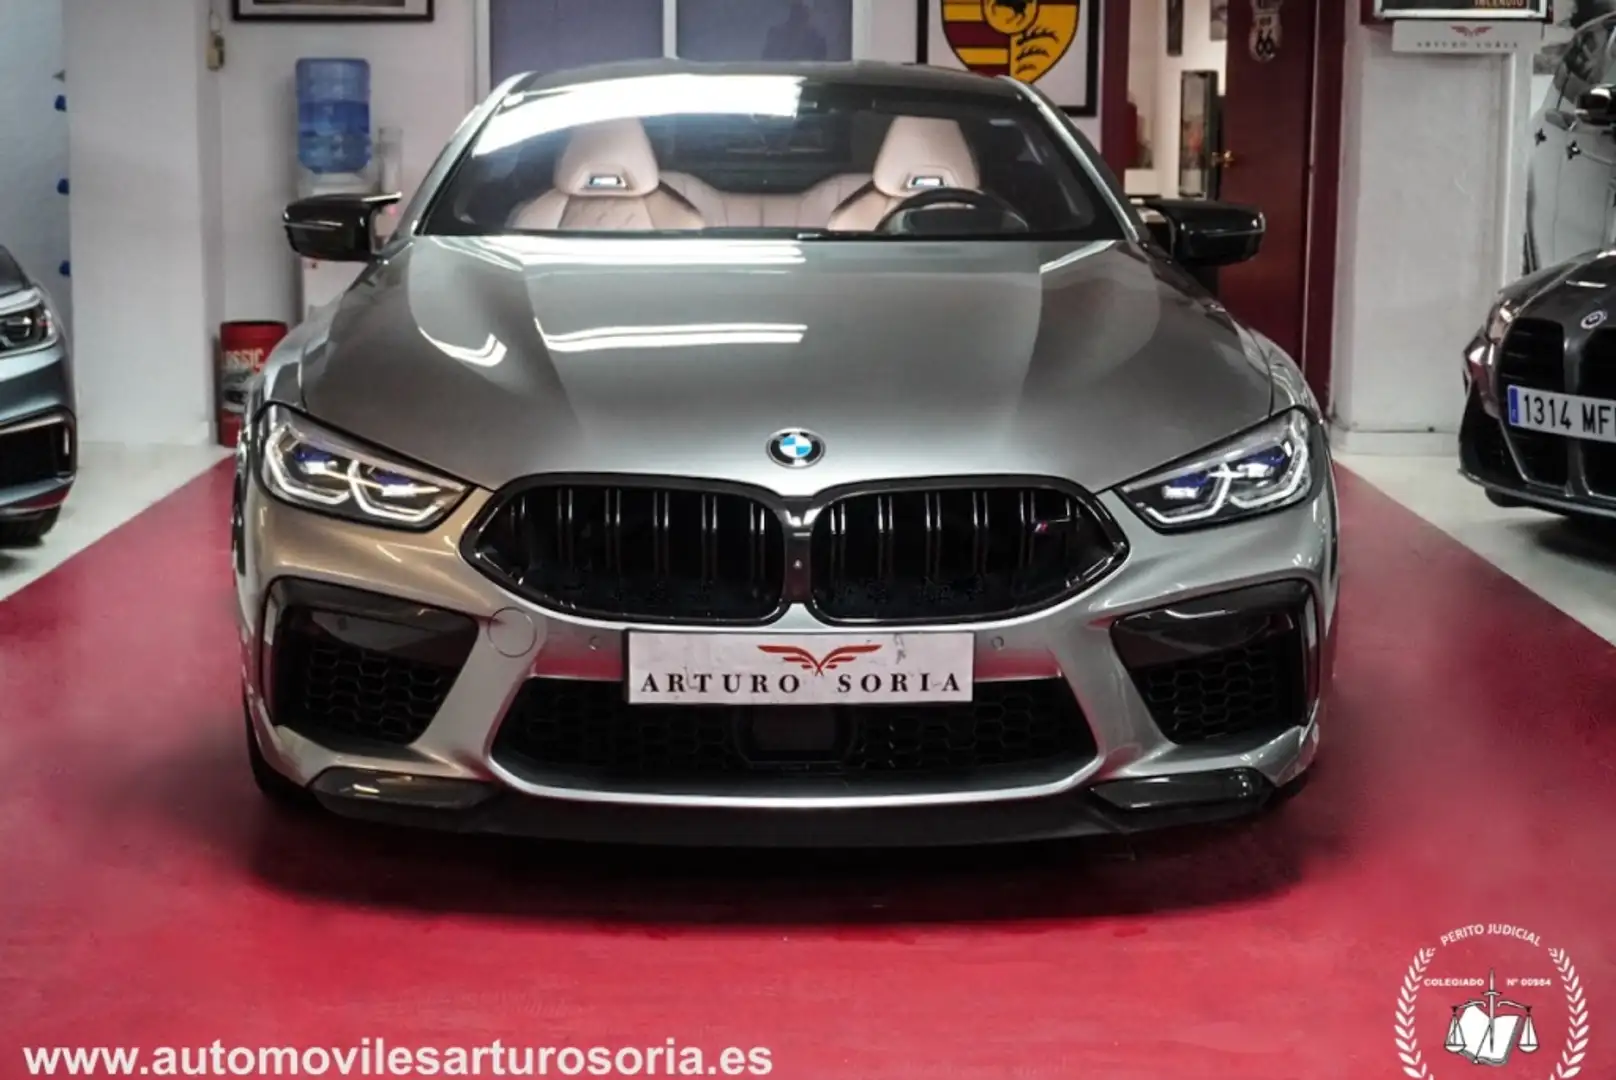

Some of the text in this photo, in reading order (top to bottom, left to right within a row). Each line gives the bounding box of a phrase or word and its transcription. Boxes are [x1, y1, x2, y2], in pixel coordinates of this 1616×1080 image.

[1524, 393, 1616, 436] 1314 MF
[641, 673, 961, 693] ARTURO SORIA
